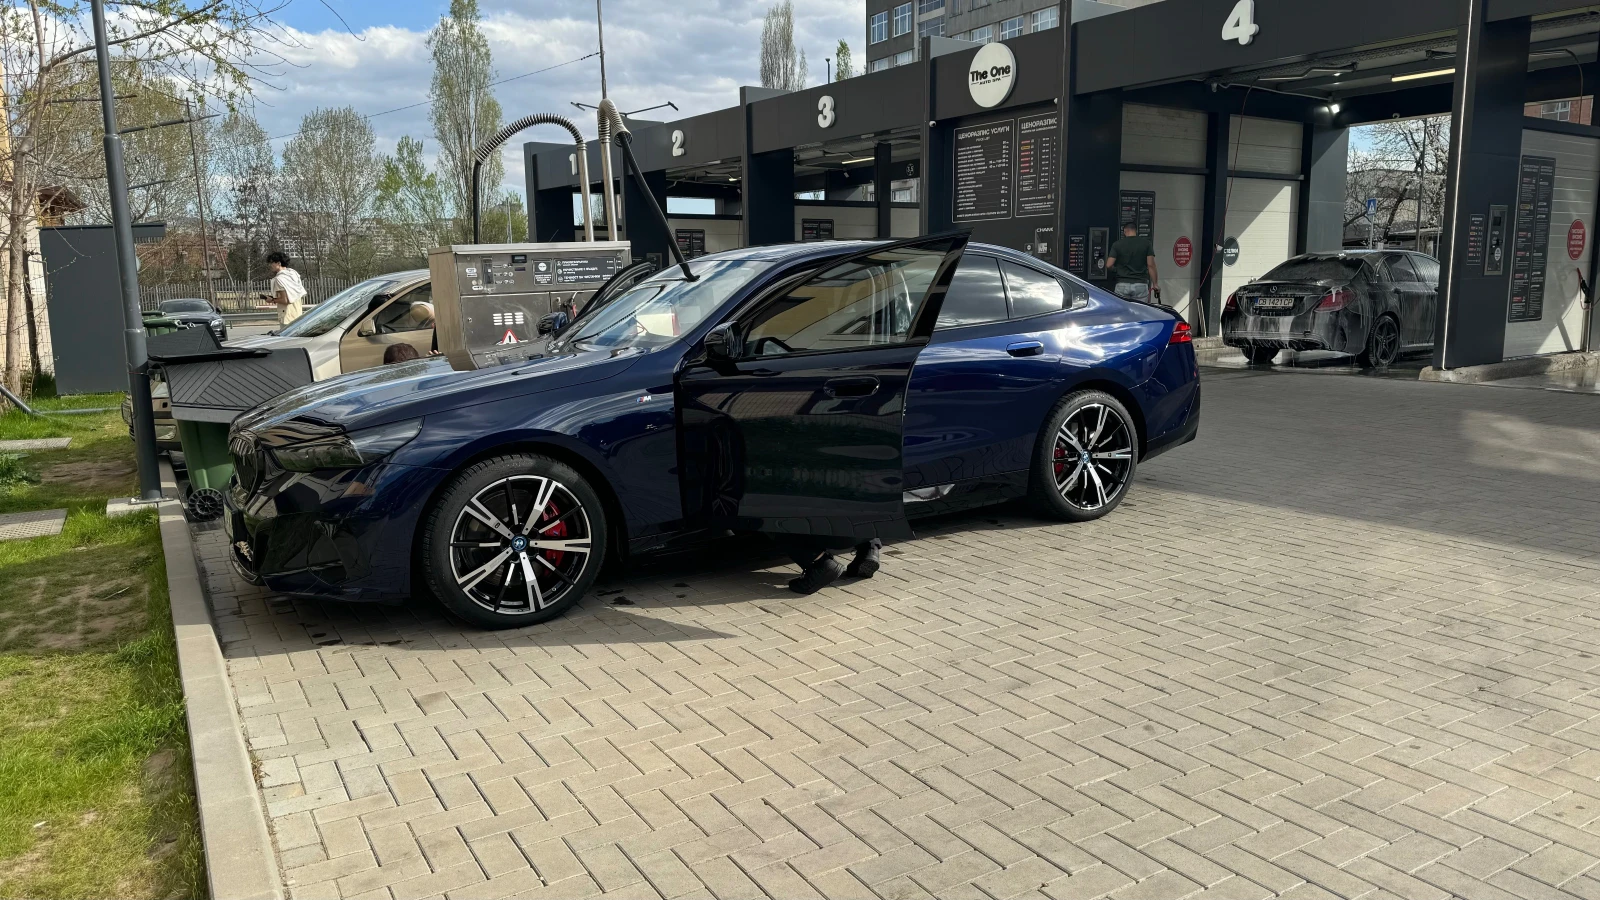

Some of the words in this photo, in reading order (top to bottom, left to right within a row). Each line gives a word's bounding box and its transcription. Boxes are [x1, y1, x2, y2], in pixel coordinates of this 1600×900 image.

[1222, 0, 1259, 45] 4
[970, 70, 988, 82] The
[990, 65, 1011, 77] One
[817, 95, 835, 128] 3
[672, 129, 685, 156] 2
[958, 129, 990, 140] ЦЕНОРАЗПИС
[569, 153, 578, 175] 1
[1267, 298, 1283, 306] 1421
